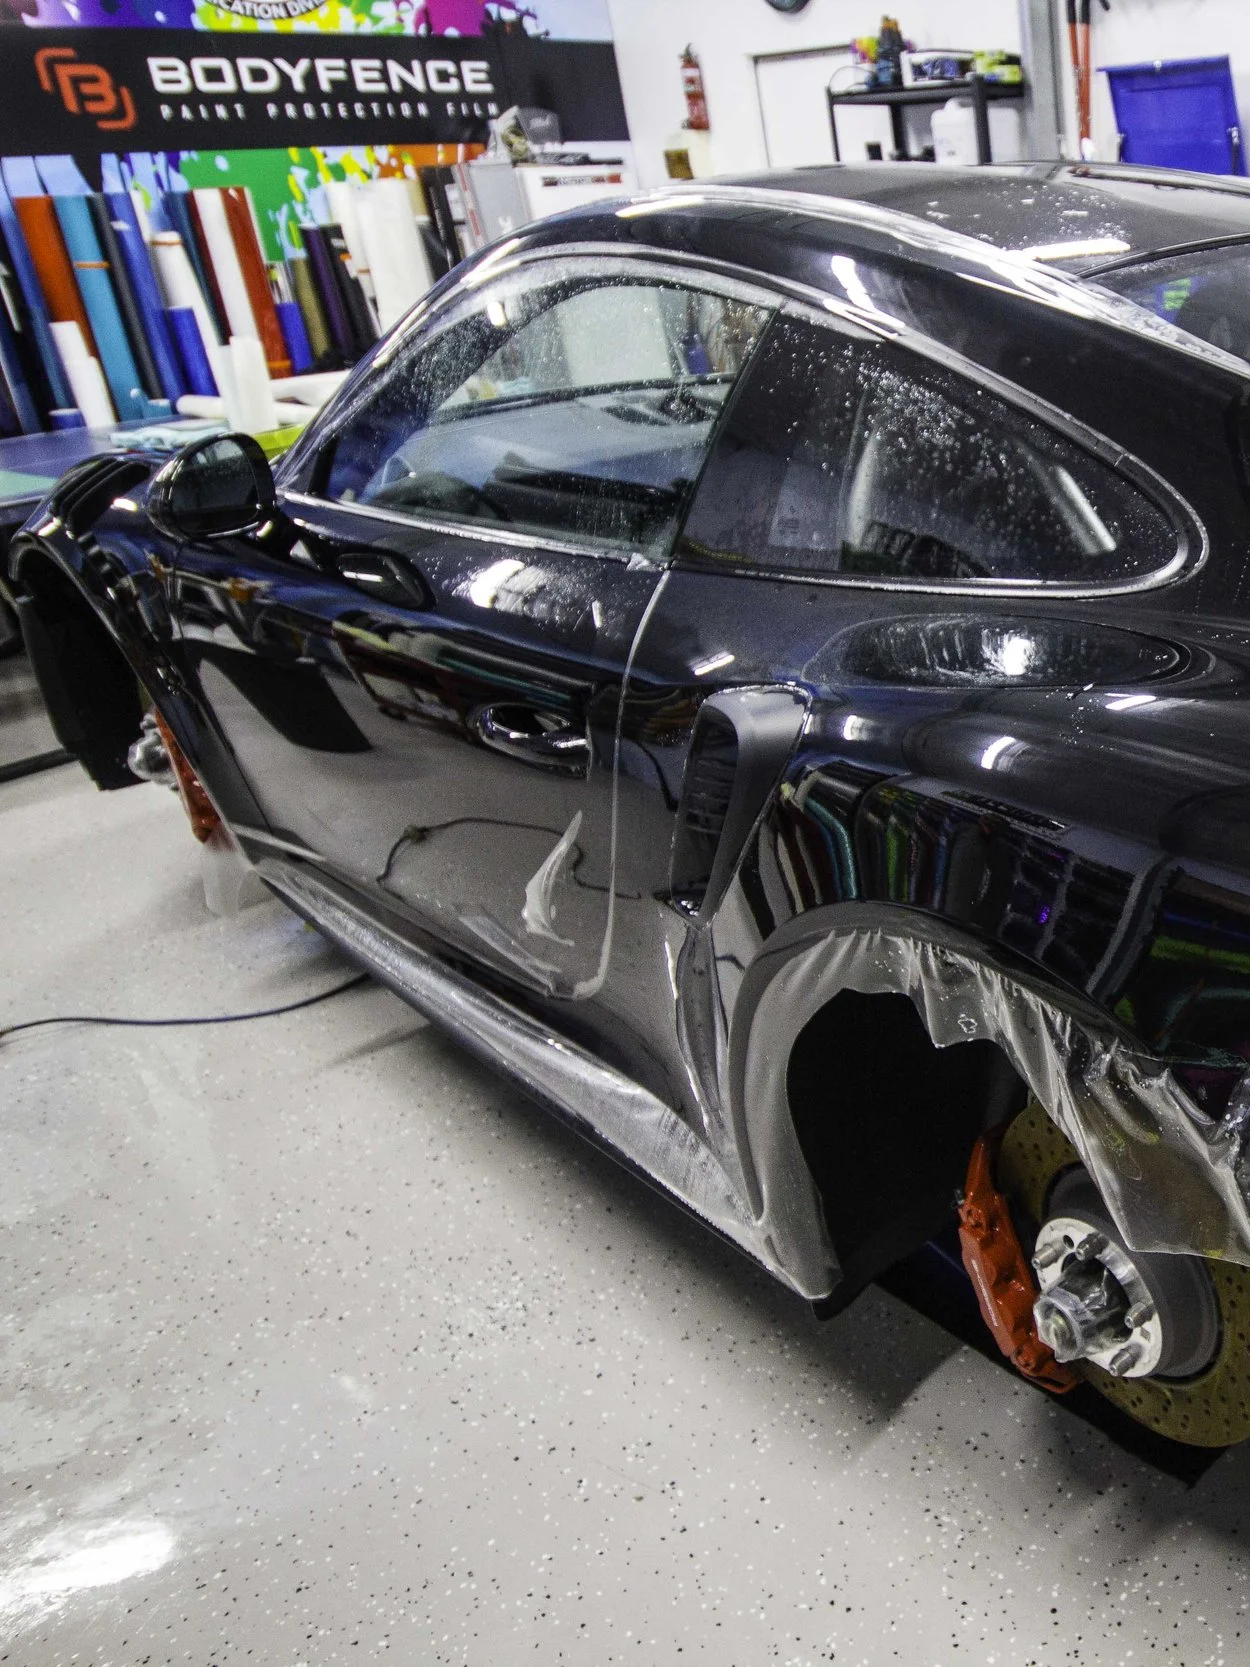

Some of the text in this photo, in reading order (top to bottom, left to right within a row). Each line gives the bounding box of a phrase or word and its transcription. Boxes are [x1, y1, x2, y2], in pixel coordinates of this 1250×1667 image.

[212, 0, 287, 19] CATION
[147, 56, 495, 94] BODYFENCE
[160, 102, 247, 121] PAINT
[266, 101, 430, 120] PROTECTION
